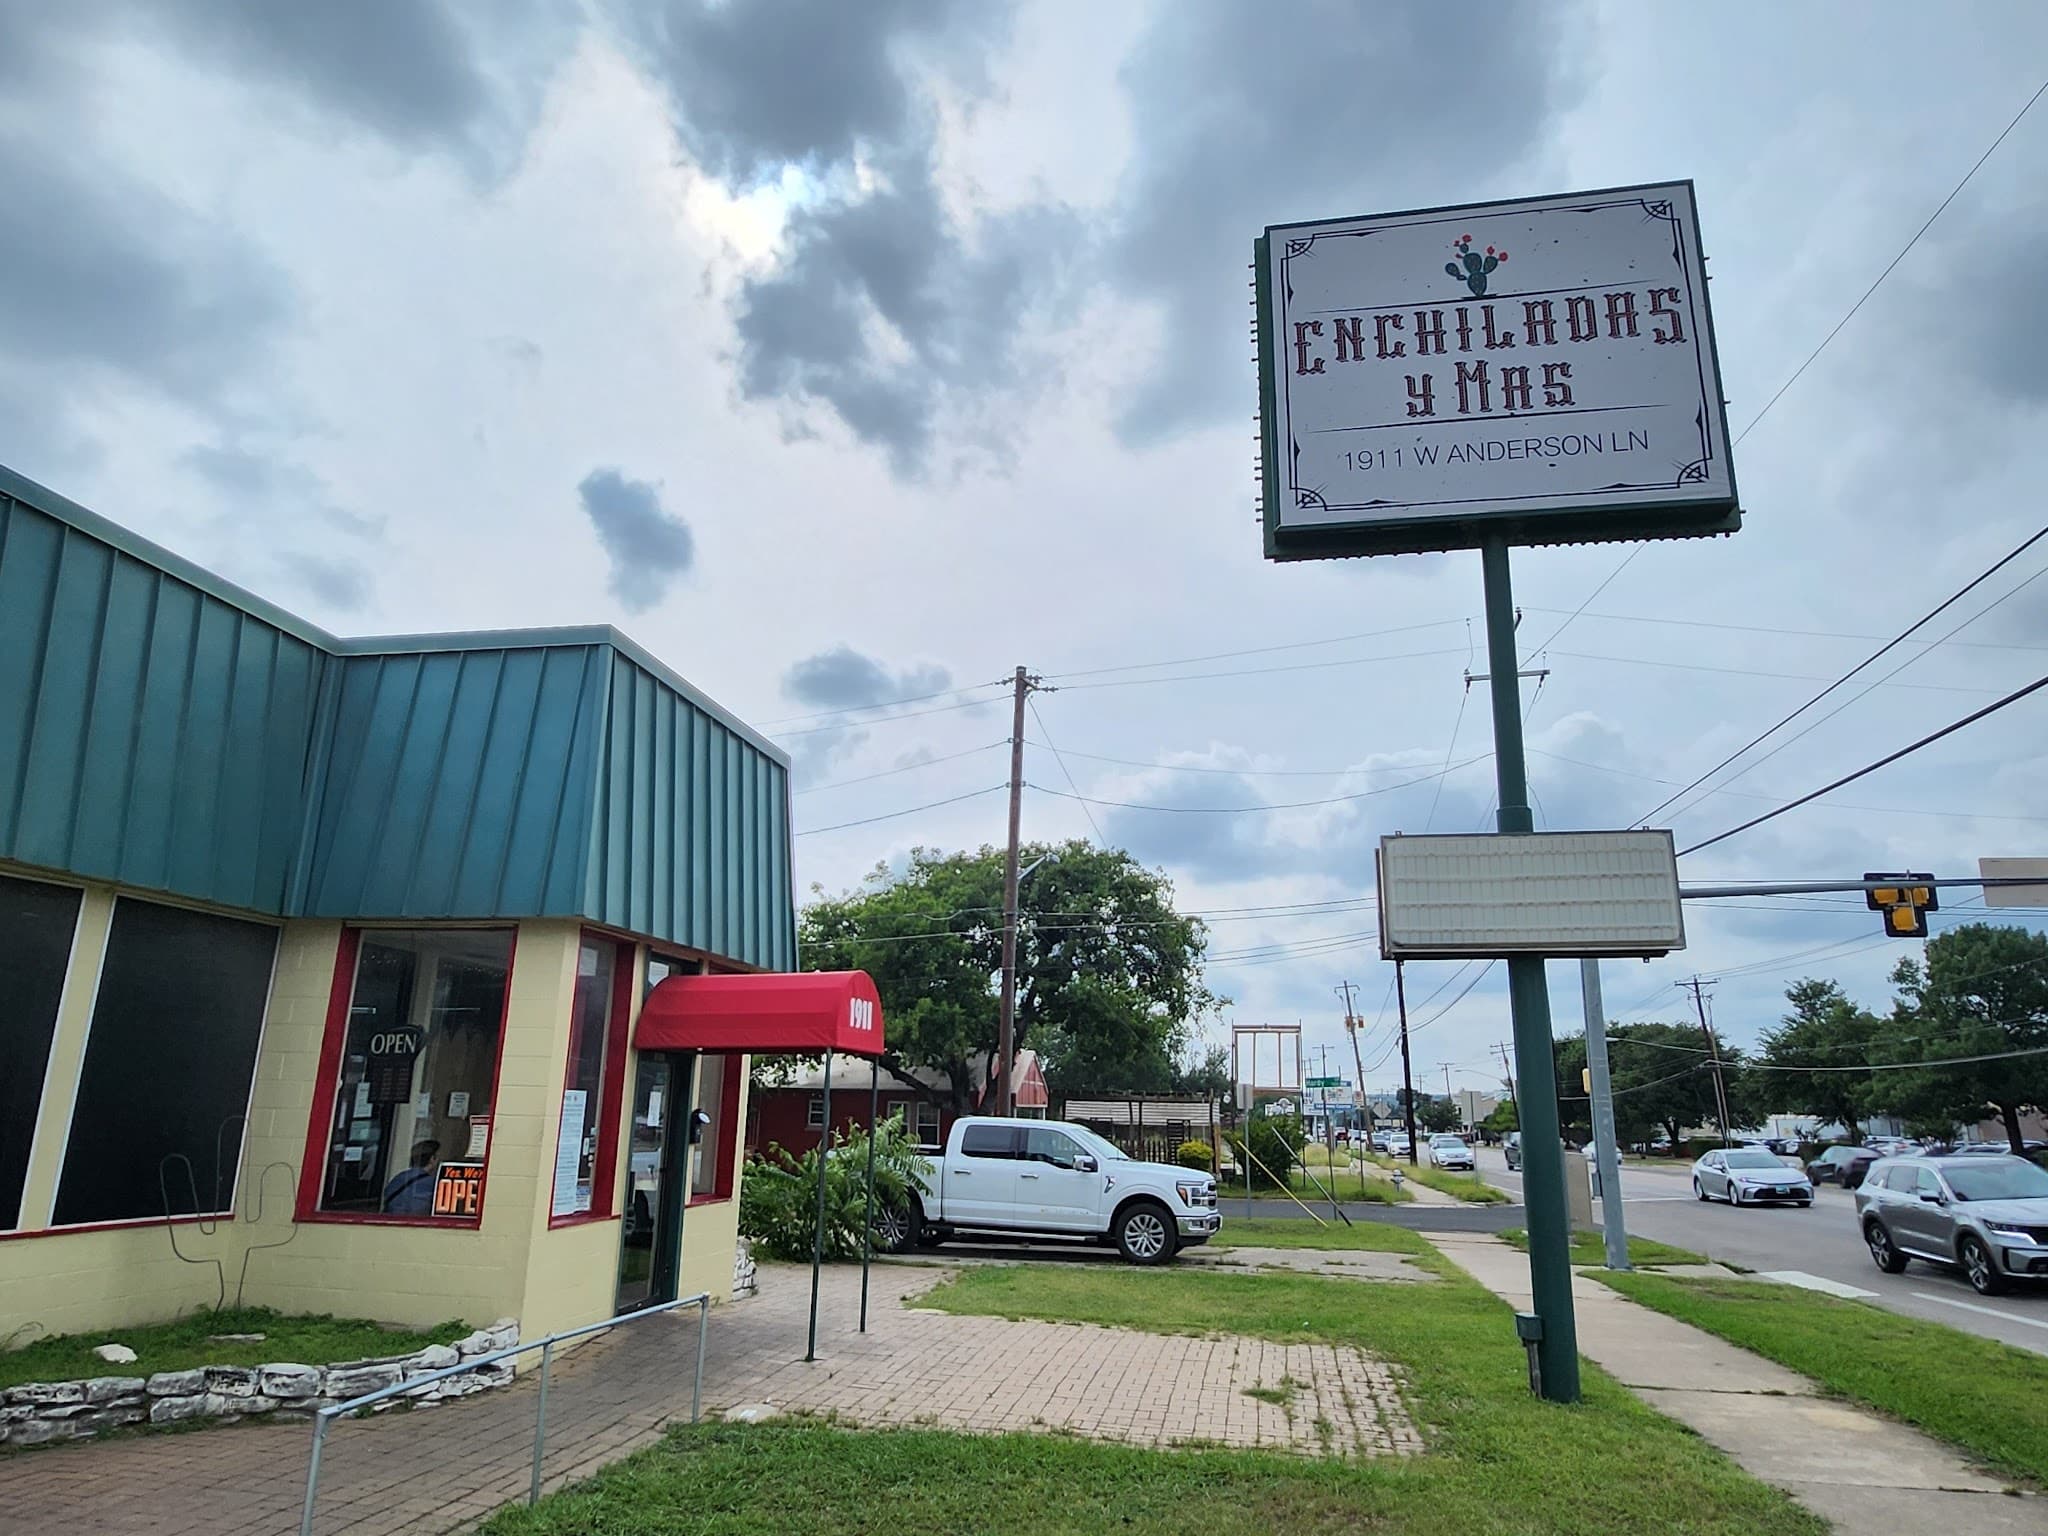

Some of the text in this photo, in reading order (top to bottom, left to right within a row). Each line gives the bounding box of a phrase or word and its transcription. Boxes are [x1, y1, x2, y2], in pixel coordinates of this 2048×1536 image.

[1294, 287, 1687, 376] ENCHILADAS
[1454, 360, 1577, 413] MAS
[1344, 429, 1649, 472] 1911 W ANDERSON LN
[850, 997, 873, 1031] 1911
[370, 1033, 417, 1054] OPEN
[436, 1180, 481, 1214] OPE
